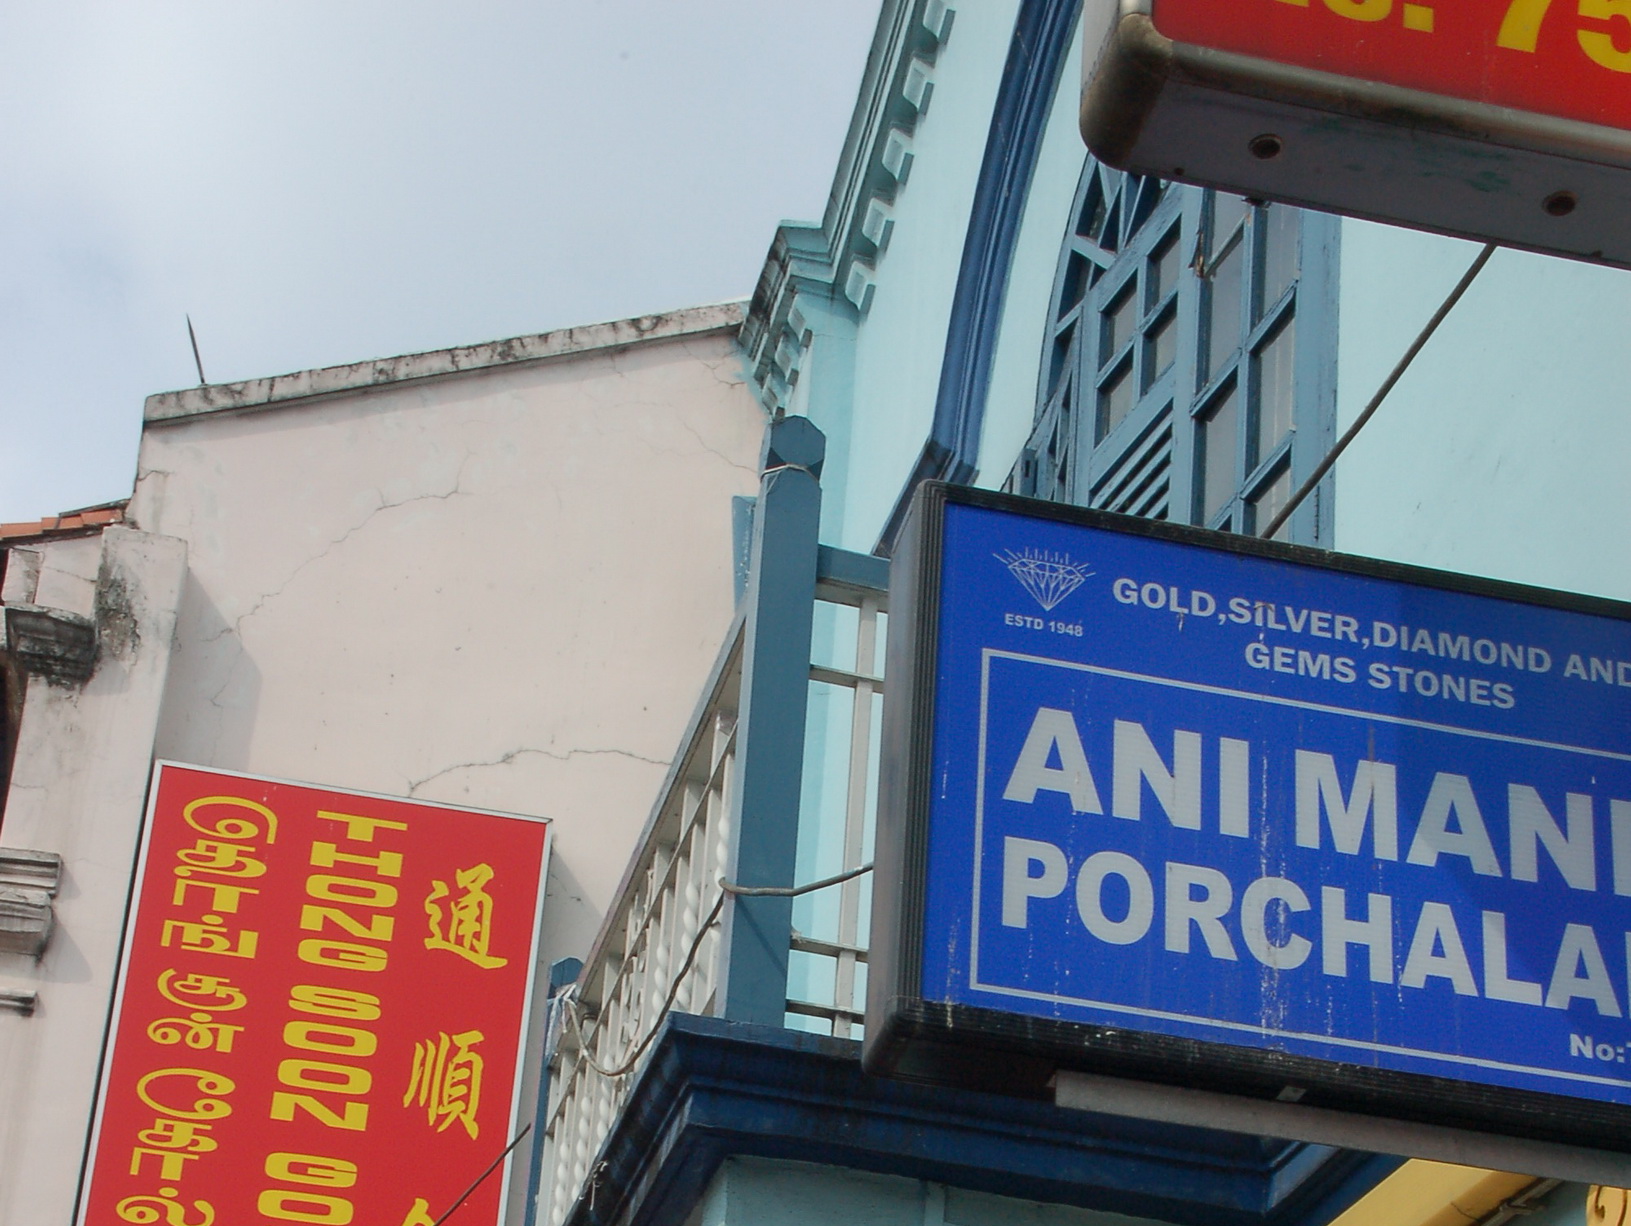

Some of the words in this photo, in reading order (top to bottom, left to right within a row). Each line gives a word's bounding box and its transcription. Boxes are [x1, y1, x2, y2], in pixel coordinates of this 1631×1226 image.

[1004, 612, 1044, 630] ESTD
[1048, 620, 1083, 637] 1948
[1245, 641, 1357, 685] GEMS
[1368, 663, 1516, 710] STONES
[1563, 654, 1631, 688] AND
[1002, 705, 1251, 839] ANI
[1295, 748, 1631, 899] MANI
[160, 795, 278, 959] தொங்
[297, 810, 408, 972] THONG
[1001, 835, 1631, 1021] PORCHALA
[270, 984, 381, 1131] SOON
[1569, 1033, 1631, 1064] No:
